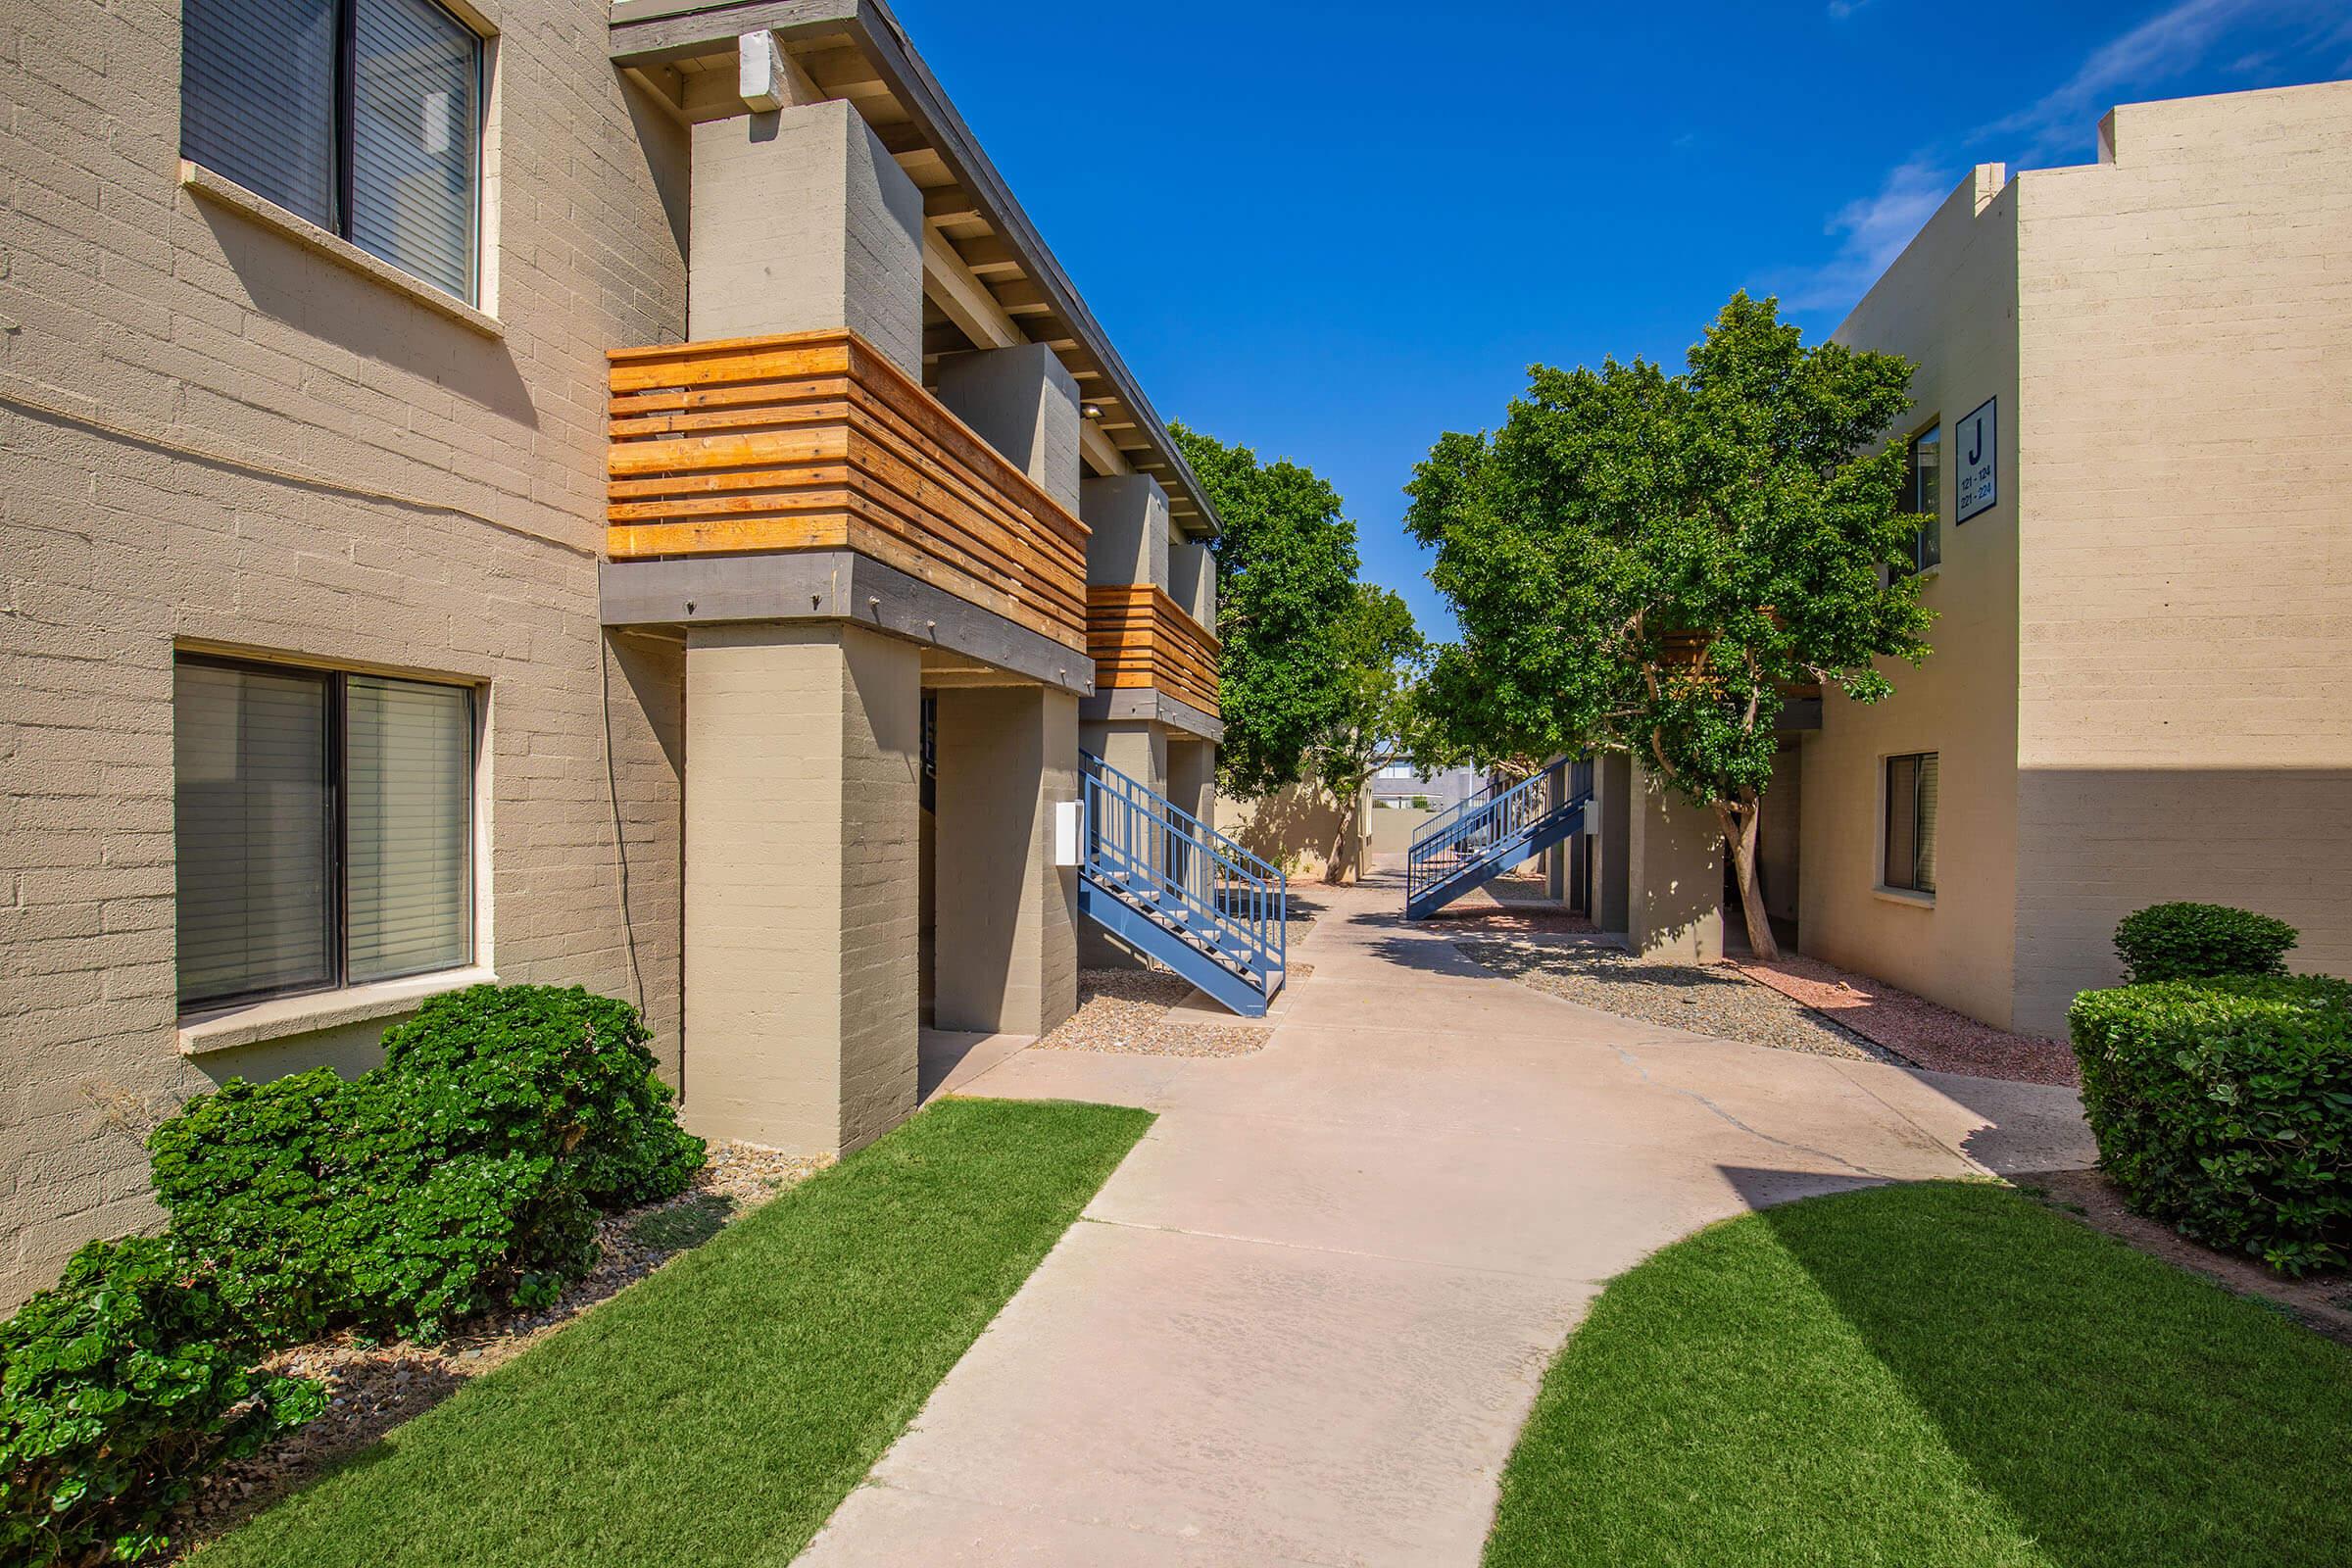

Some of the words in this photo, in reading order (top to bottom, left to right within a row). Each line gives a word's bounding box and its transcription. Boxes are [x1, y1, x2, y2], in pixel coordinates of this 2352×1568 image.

[1969, 417, 1983, 466] J
[1961, 476, 1972, 492] 121
[1979, 466, 1990, 482] 124
[1961, 493, 1972, 510] 221
[1978, 482, 1991, 500] 224
